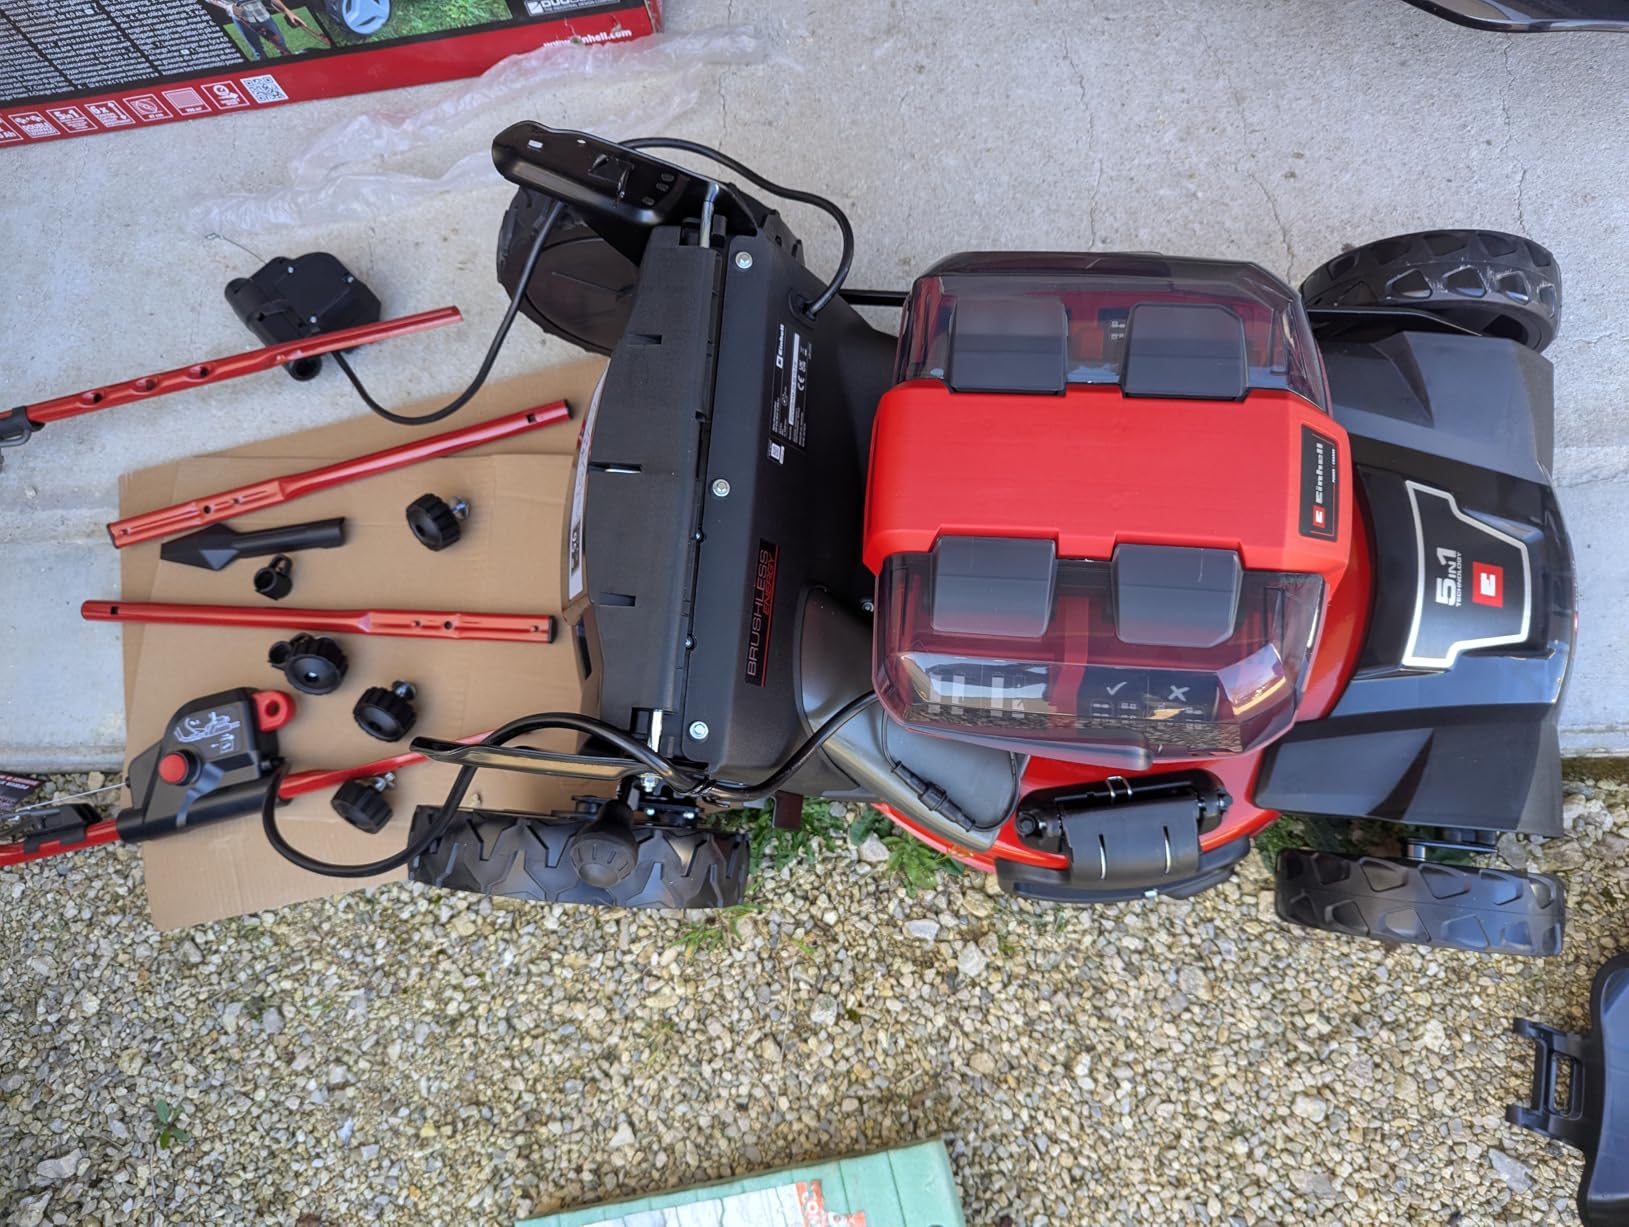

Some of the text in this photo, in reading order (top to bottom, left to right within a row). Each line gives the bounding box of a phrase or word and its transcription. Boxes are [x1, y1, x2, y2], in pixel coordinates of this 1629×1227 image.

[1315, 442, 1324, 504] Einhell
[747, 549, 769, 677] BRUSHLESS
[763, 552, 775, 617] ENERGY
